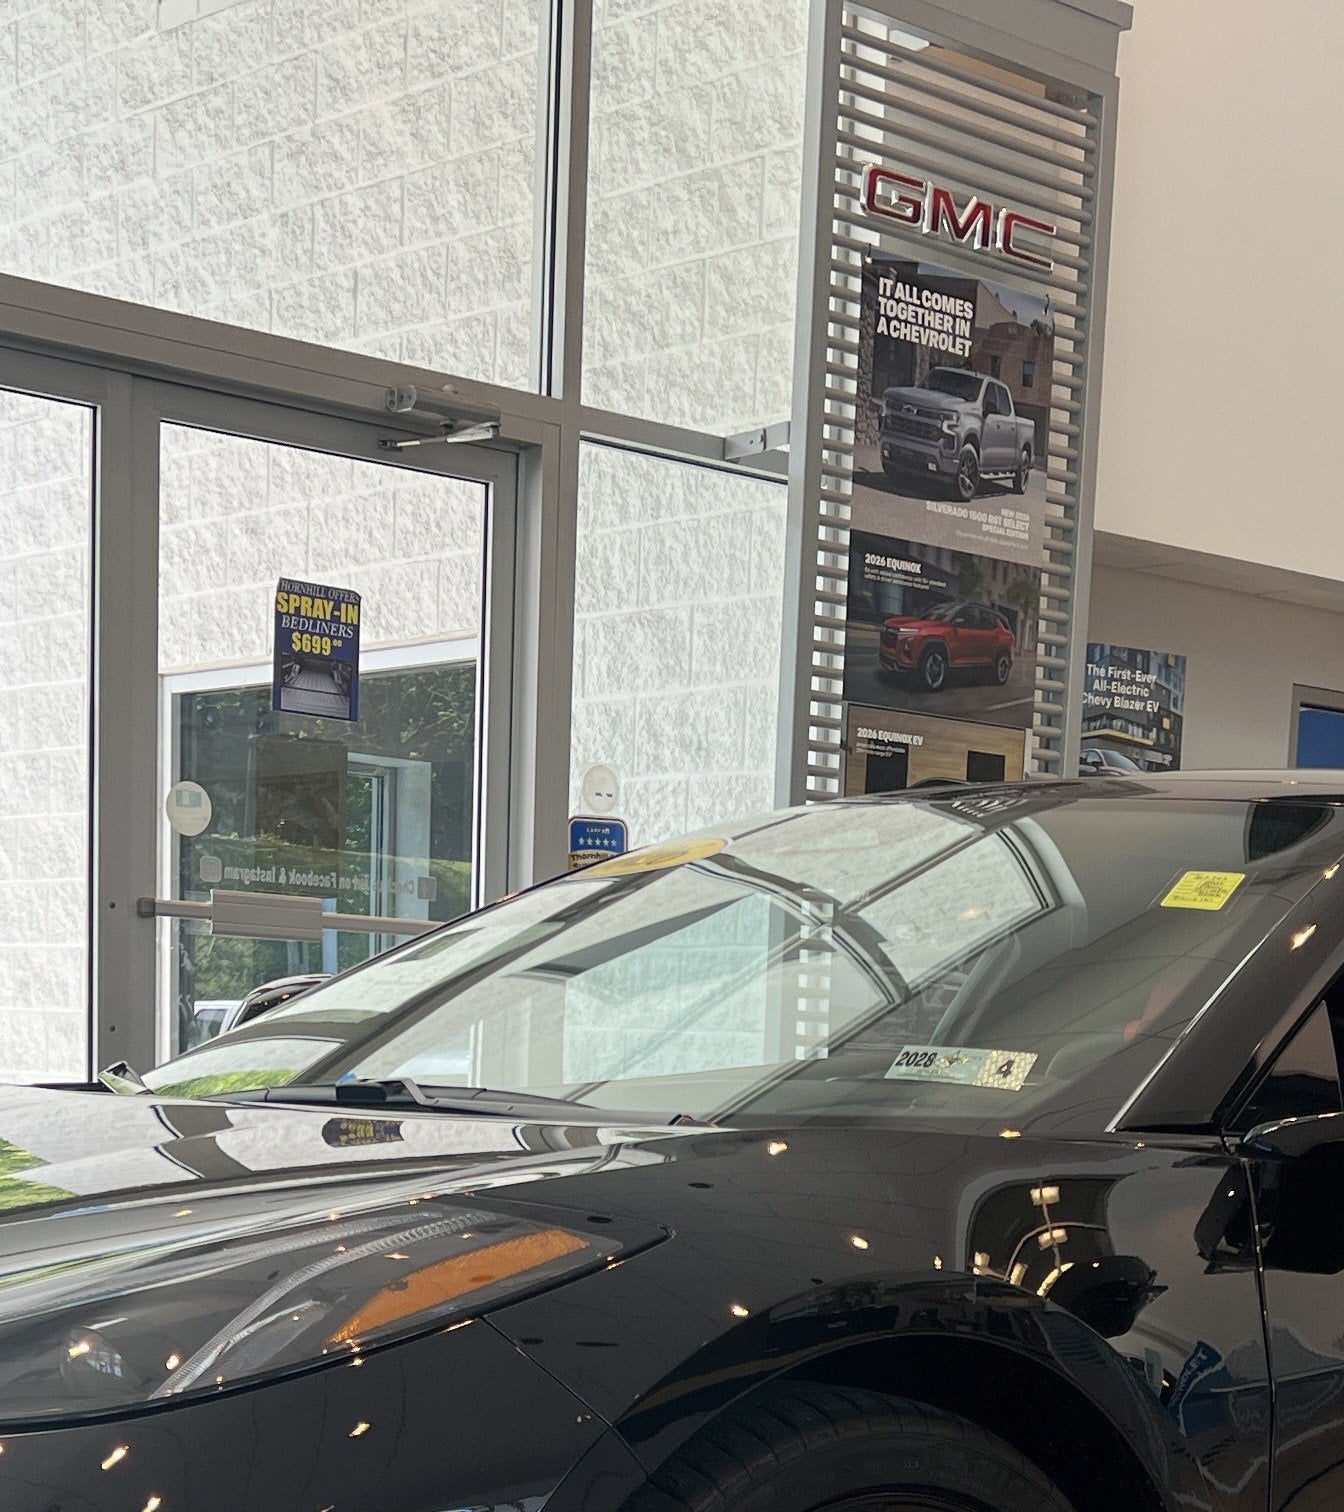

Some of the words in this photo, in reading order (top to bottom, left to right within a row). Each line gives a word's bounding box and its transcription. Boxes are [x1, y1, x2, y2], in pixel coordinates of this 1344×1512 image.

[859, 162, 1057, 273] GMC
[879, 277, 894, 297] IT
[894, 282, 921, 305] ALL
[921, 289, 974, 319] COMES
[878, 296, 954, 334] TOGETHER
[955, 318, 971, 338] IN
[876, 316, 888, 336] A
[889, 320, 972, 357] CHEVROLET
[926, 500, 969, 518] SILVERADO
[969, 510, 987, 522] 1500
[864, 553, 886, 567] 2026
[886, 557, 922, 573] EQUINOX
[276, 591, 359, 625] SPRAY-IN
[281, 614, 354, 639] BEDLINERS
[1086, 663, 1106, 677] The
[1107, 666, 1157, 683] First-Ever
[1092, 679, 1150, 697] All-Electric
[1113, 696, 1146, 711] Blazer
[1146, 700, 1160, 713] EV
[856, 727, 878, 740] 2026
[878, 730, 913, 744] EQUINOX
[913, 735, 924, 746] EV
[996, 1059, 1016, 1079] 4
